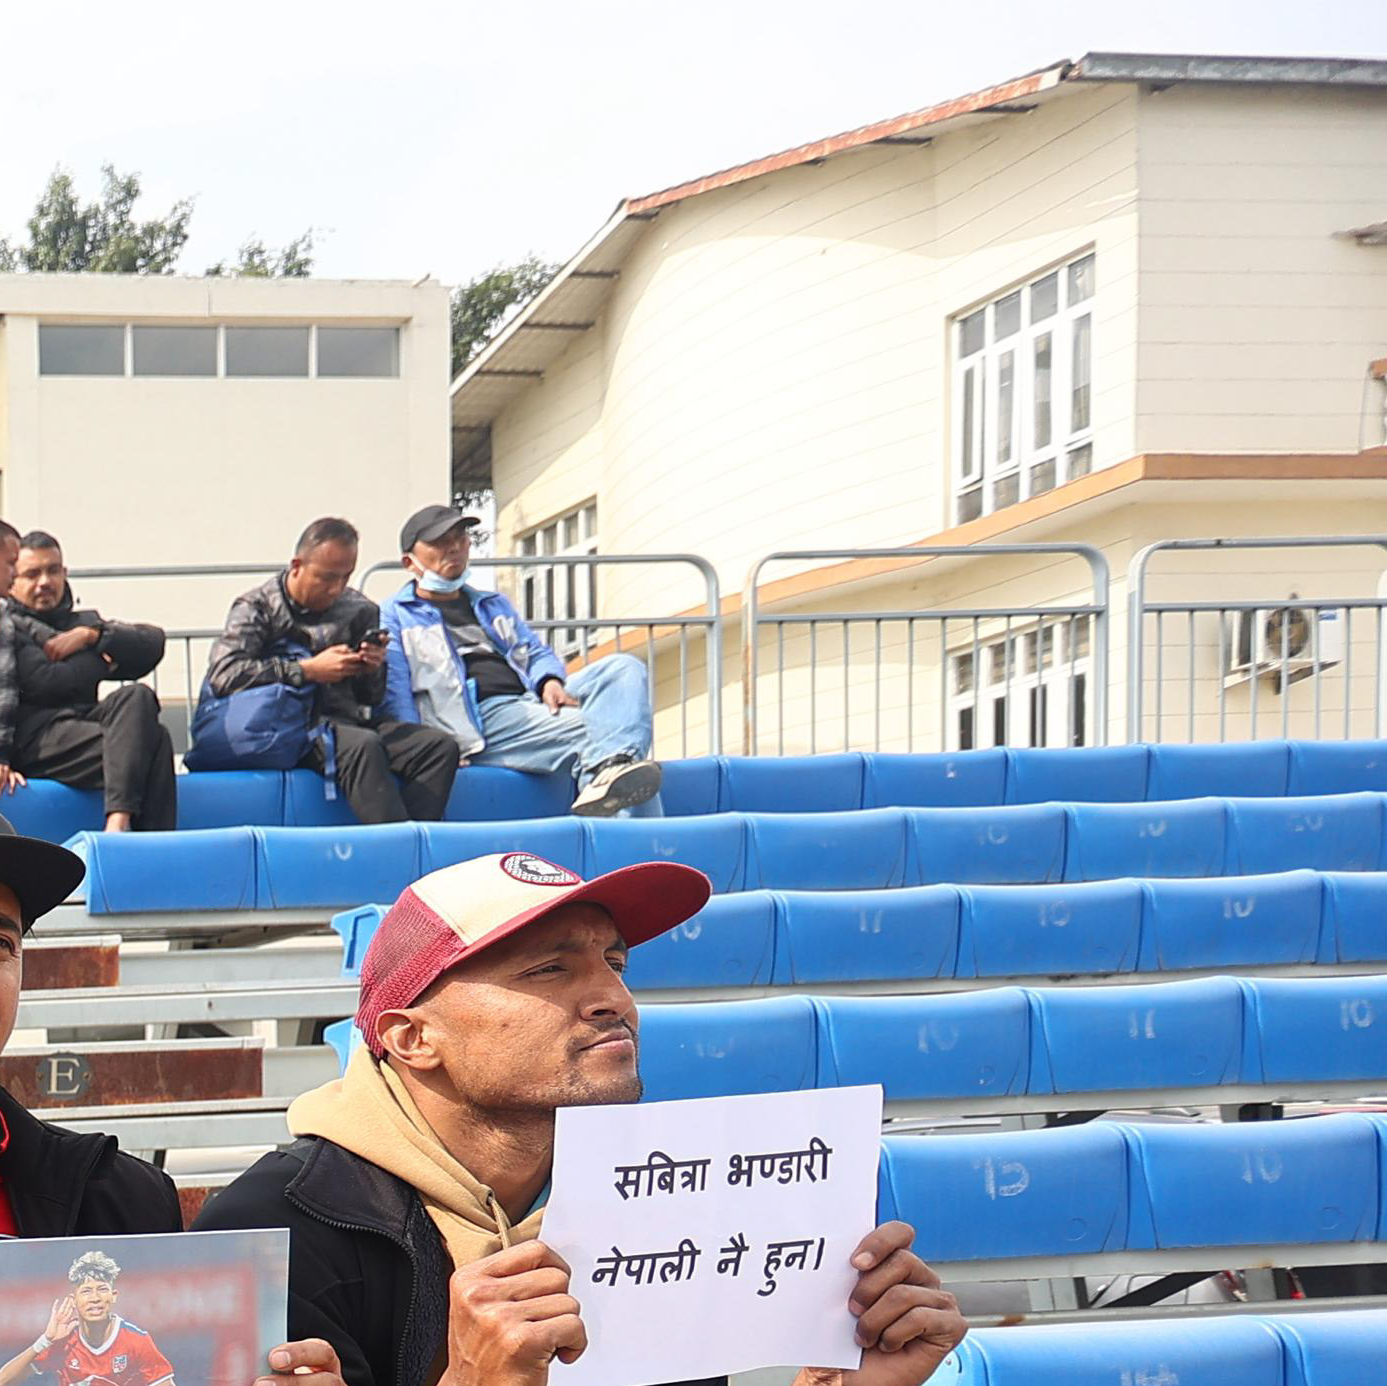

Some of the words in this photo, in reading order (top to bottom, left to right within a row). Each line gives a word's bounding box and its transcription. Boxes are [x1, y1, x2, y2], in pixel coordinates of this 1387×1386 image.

[46, 1058, 82, 1096] E
[615, 1151, 711, 1200] सबित्रा
[728, 1137, 832, 1187] भण्डारी
[592, 1239, 701, 1286] नेपाली
[717, 1233, 749, 1276] नै
[757, 1238, 824, 1296] हुन।
